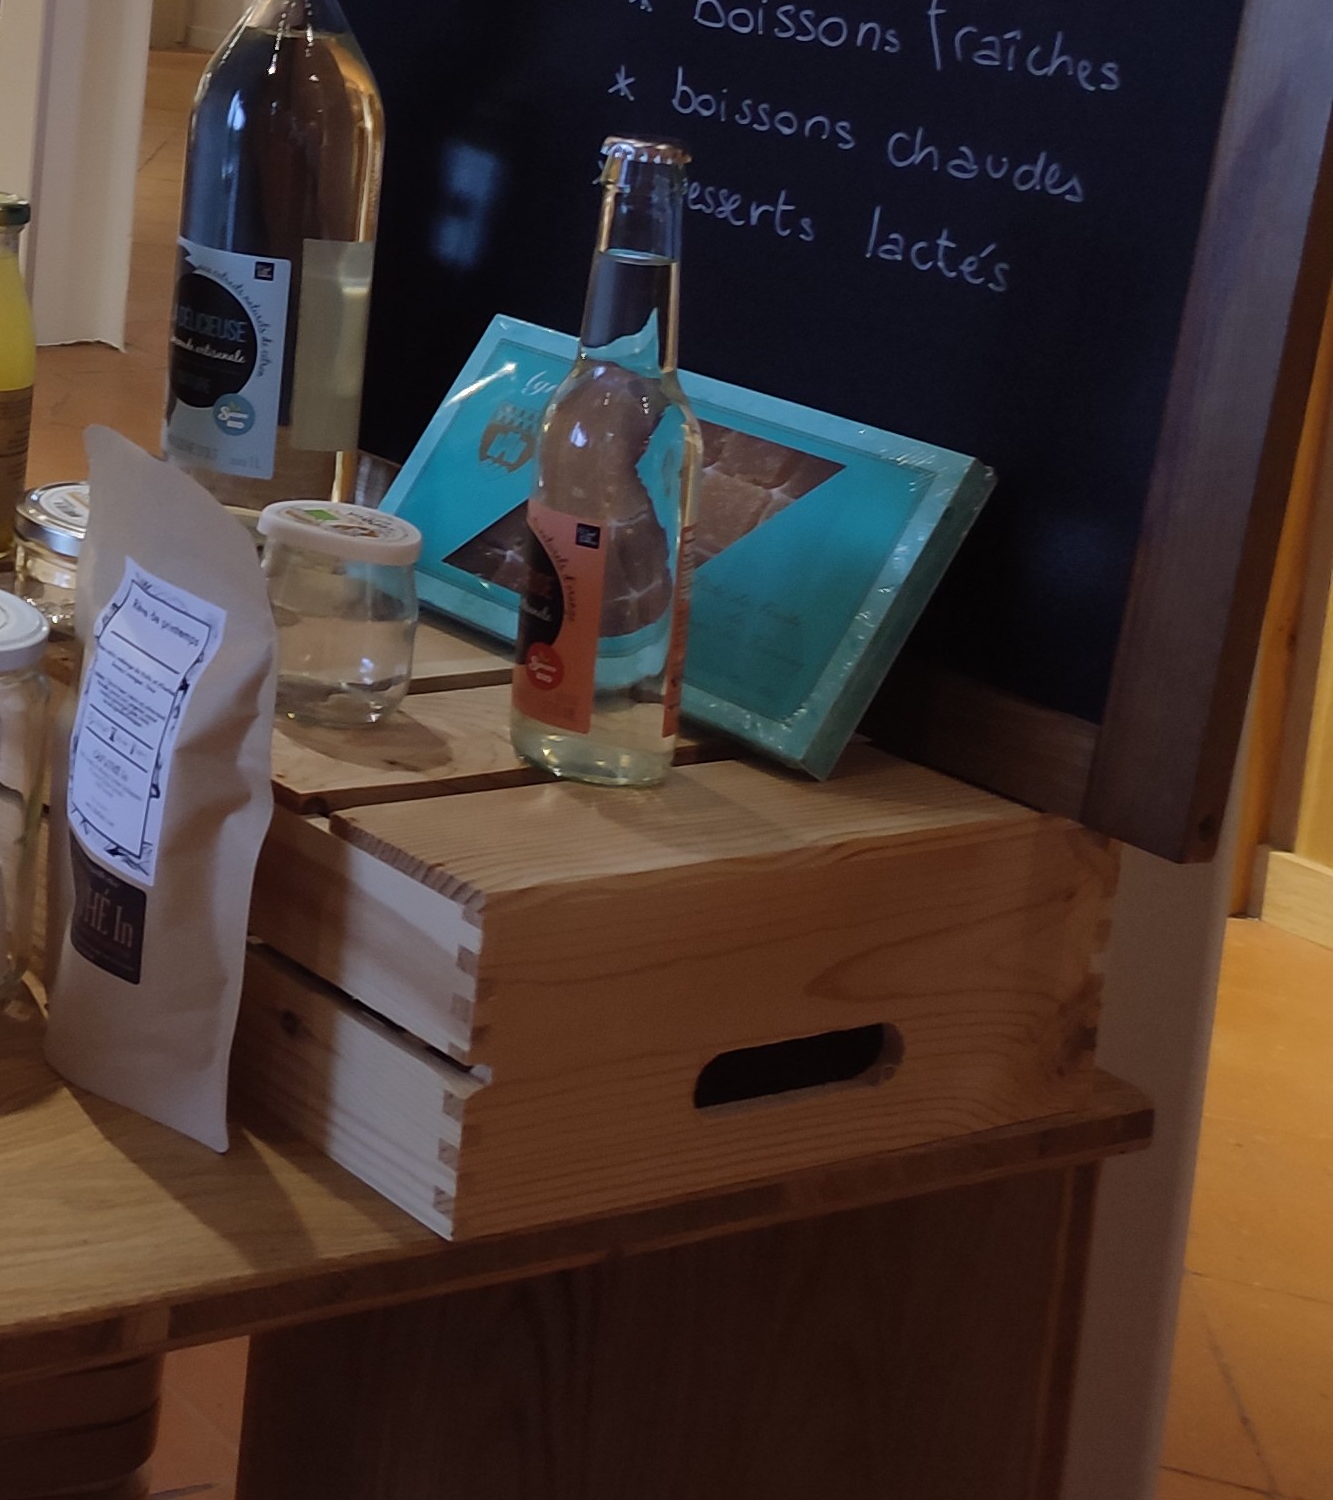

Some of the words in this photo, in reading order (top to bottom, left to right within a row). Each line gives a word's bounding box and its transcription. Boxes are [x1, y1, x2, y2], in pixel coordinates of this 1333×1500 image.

[671, 65, 855, 150] boissons
[887, 126, 1083, 203] chaudes
[683, 180, 815, 242] esserts
[865, 205, 1010, 292] lactés
